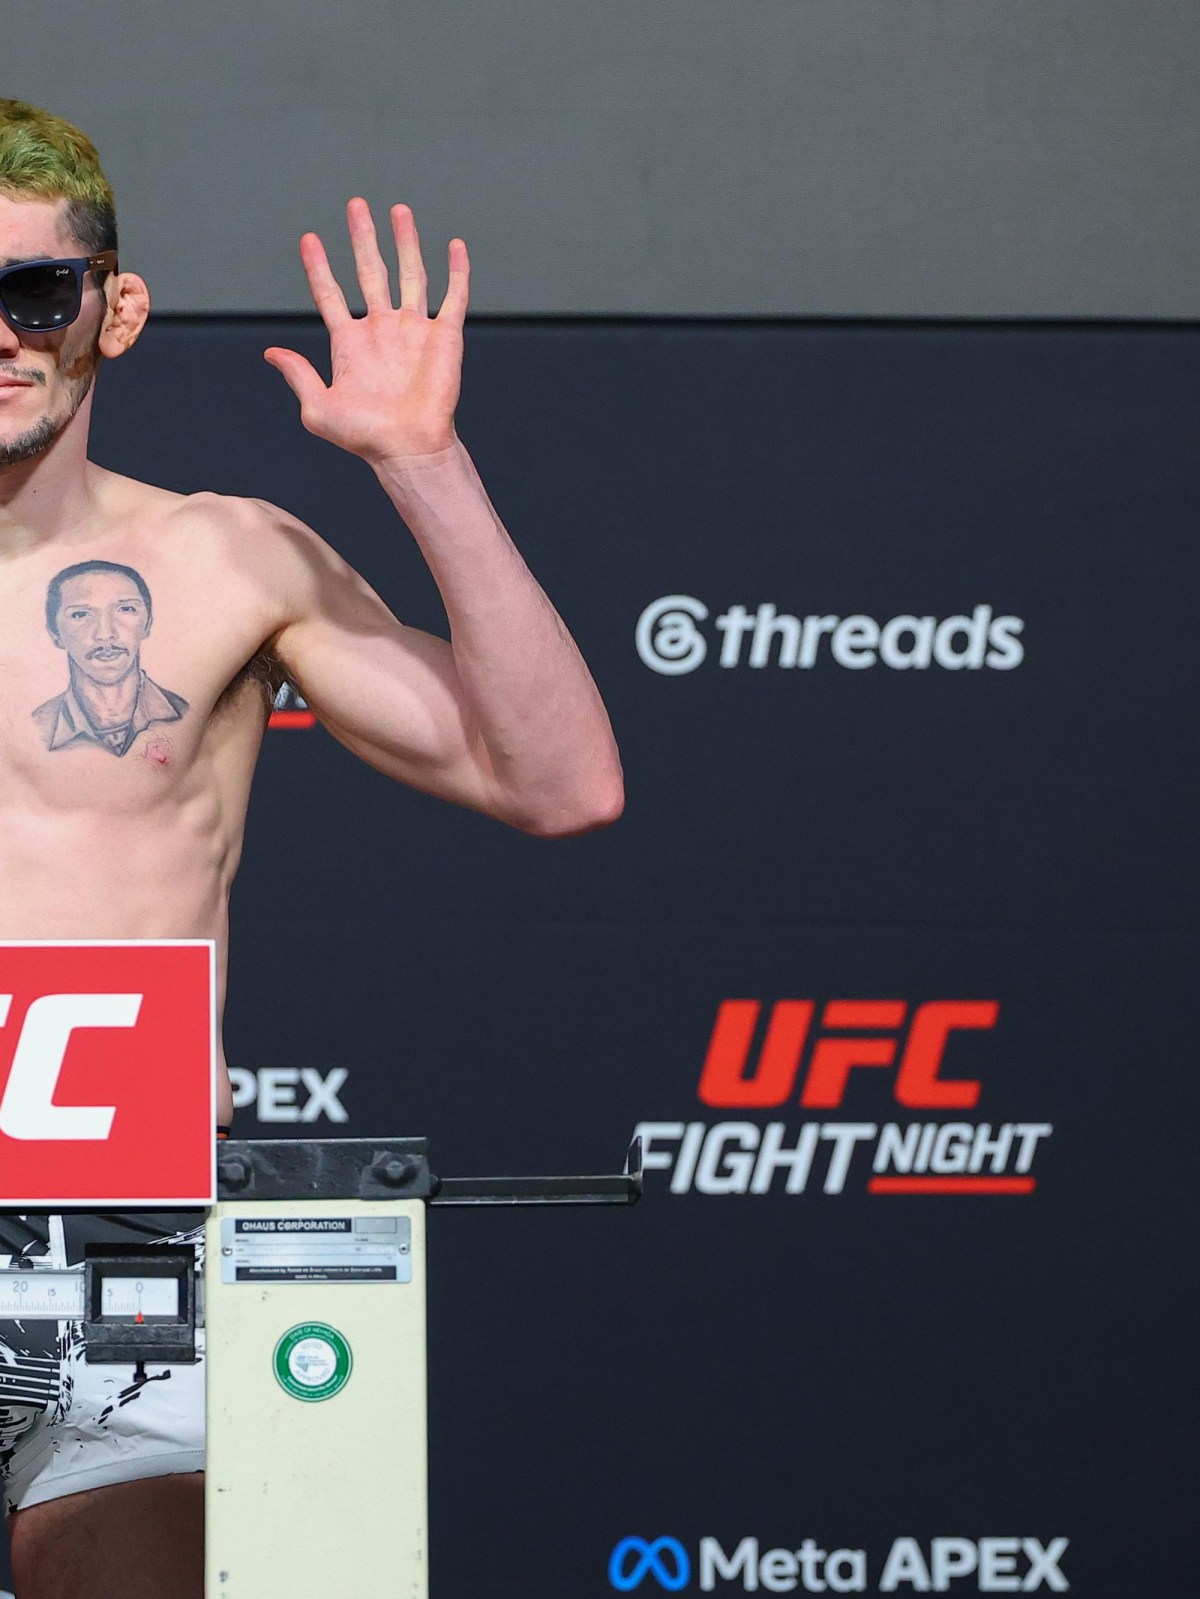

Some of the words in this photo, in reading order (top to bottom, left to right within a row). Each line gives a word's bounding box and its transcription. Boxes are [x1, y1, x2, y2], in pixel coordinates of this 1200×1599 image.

[715, 603, 1025, 670] threads
[697, 1000, 999, 1109] UFC
[624, 1122, 877, 1195] FIGHT
[872, 1122, 1053, 1174] NIGHT
[277, 1221, 346, 1231] CORPORATION
[12, 1281, 28, 1293] 20
[135, 1281, 144, 1293] 0
[47, 1288, 56, 1296] 15
[107, 1288, 113, 1297] 5
[699, 1537, 867, 1593] Meta
[879, 1537, 1069, 1592] APEX
